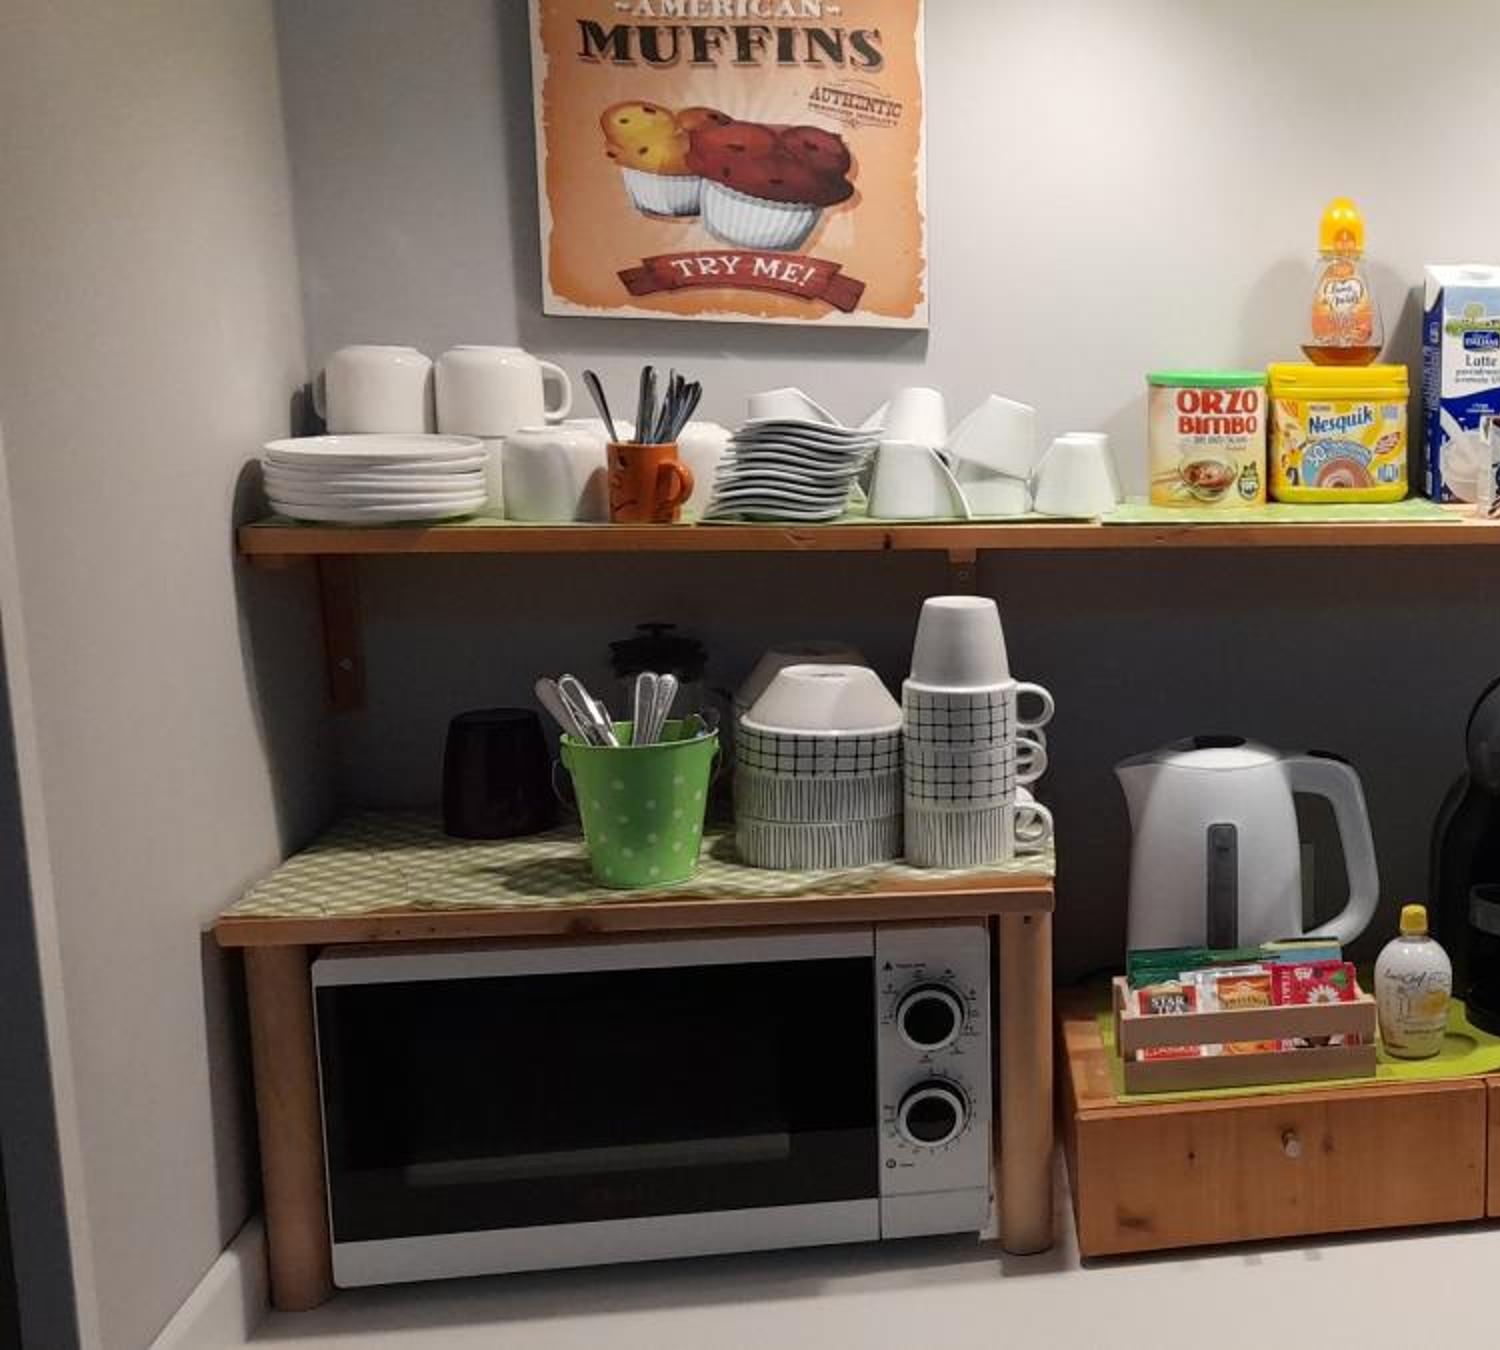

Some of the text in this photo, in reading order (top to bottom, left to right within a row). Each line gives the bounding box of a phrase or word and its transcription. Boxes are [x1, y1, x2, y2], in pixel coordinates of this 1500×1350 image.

[632, 0, 823, 18] AMERICAN
[576, 19, 884, 70] MUFFINS
[808, 85, 903, 118] AUTHENTIC
[671, 255, 816, 287] TRY ME!
[1465, 354, 1498, 367] Latte
[1177, 389, 1259, 414] ORZO
[1178, 415, 1257, 435] BIMBO
[1309, 405, 1374, 435] Nesquik
[1152, 996, 1186, 1009] STAR
